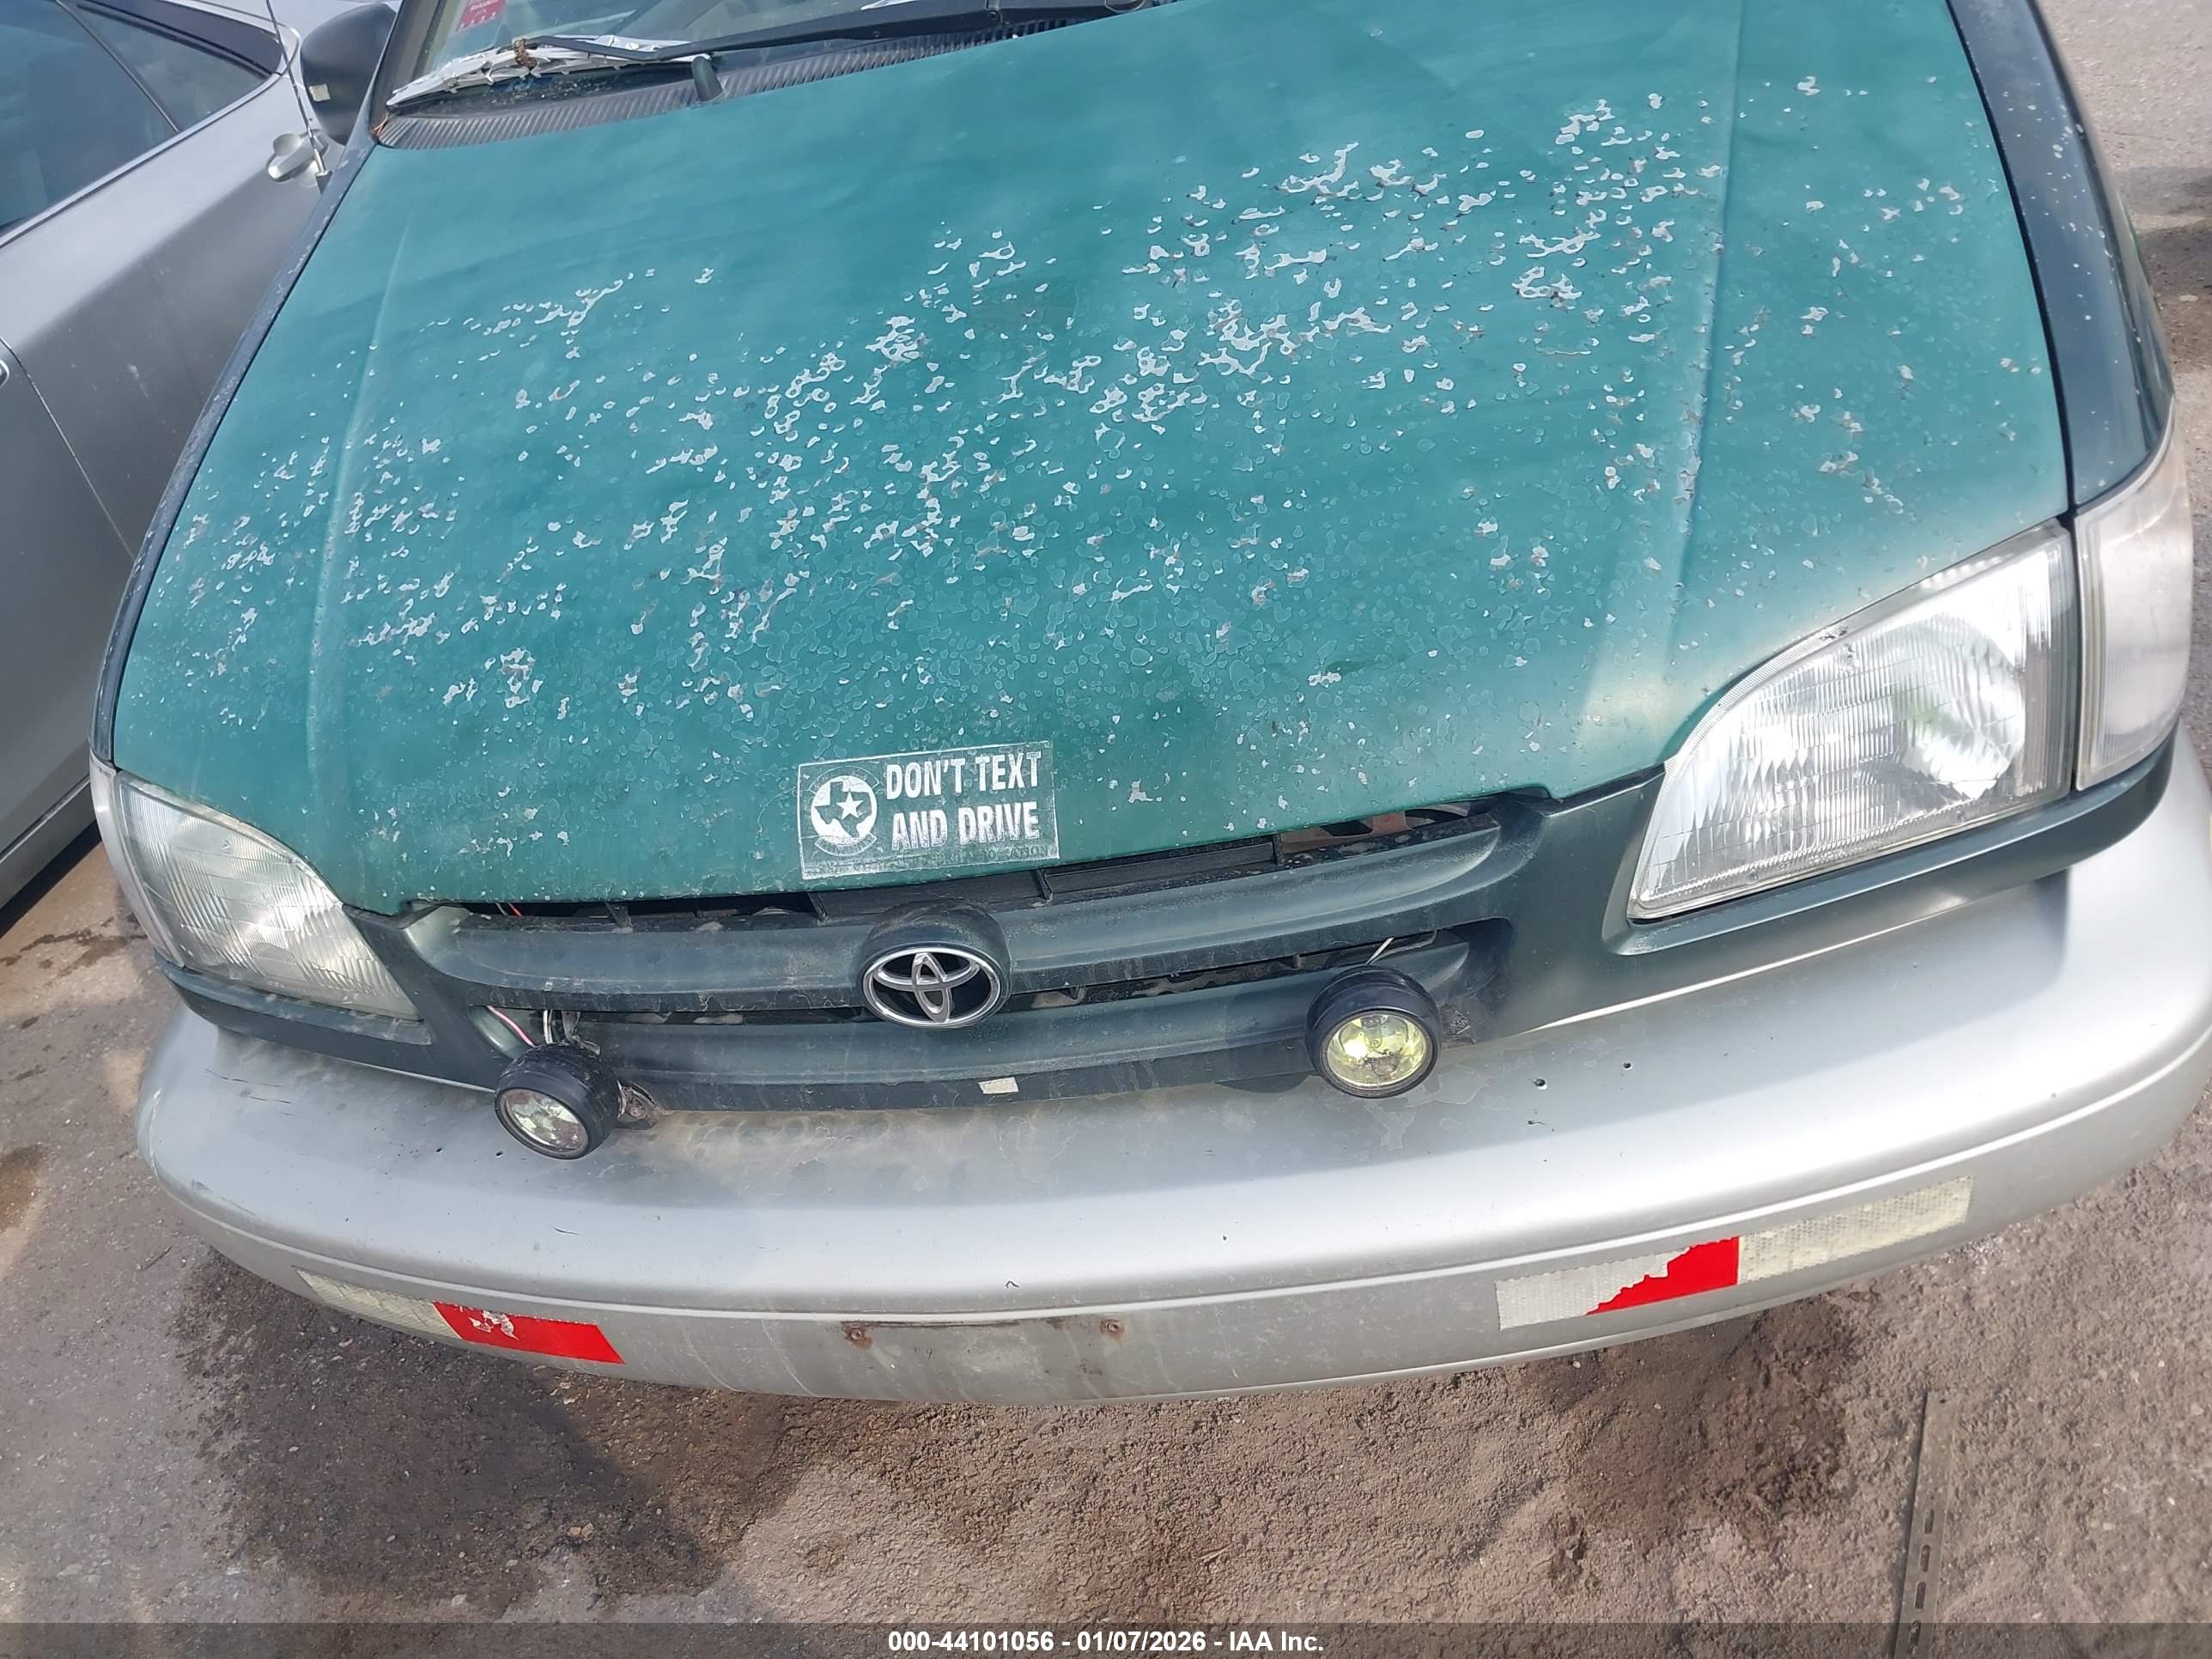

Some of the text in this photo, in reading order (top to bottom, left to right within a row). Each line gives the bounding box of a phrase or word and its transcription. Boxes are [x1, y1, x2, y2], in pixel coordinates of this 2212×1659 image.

[885, 758, 966, 800] DON'T
[975, 750, 1042, 792] TEXT
[891, 809, 948, 851] AND
[957, 800, 1041, 845] DRIVE
